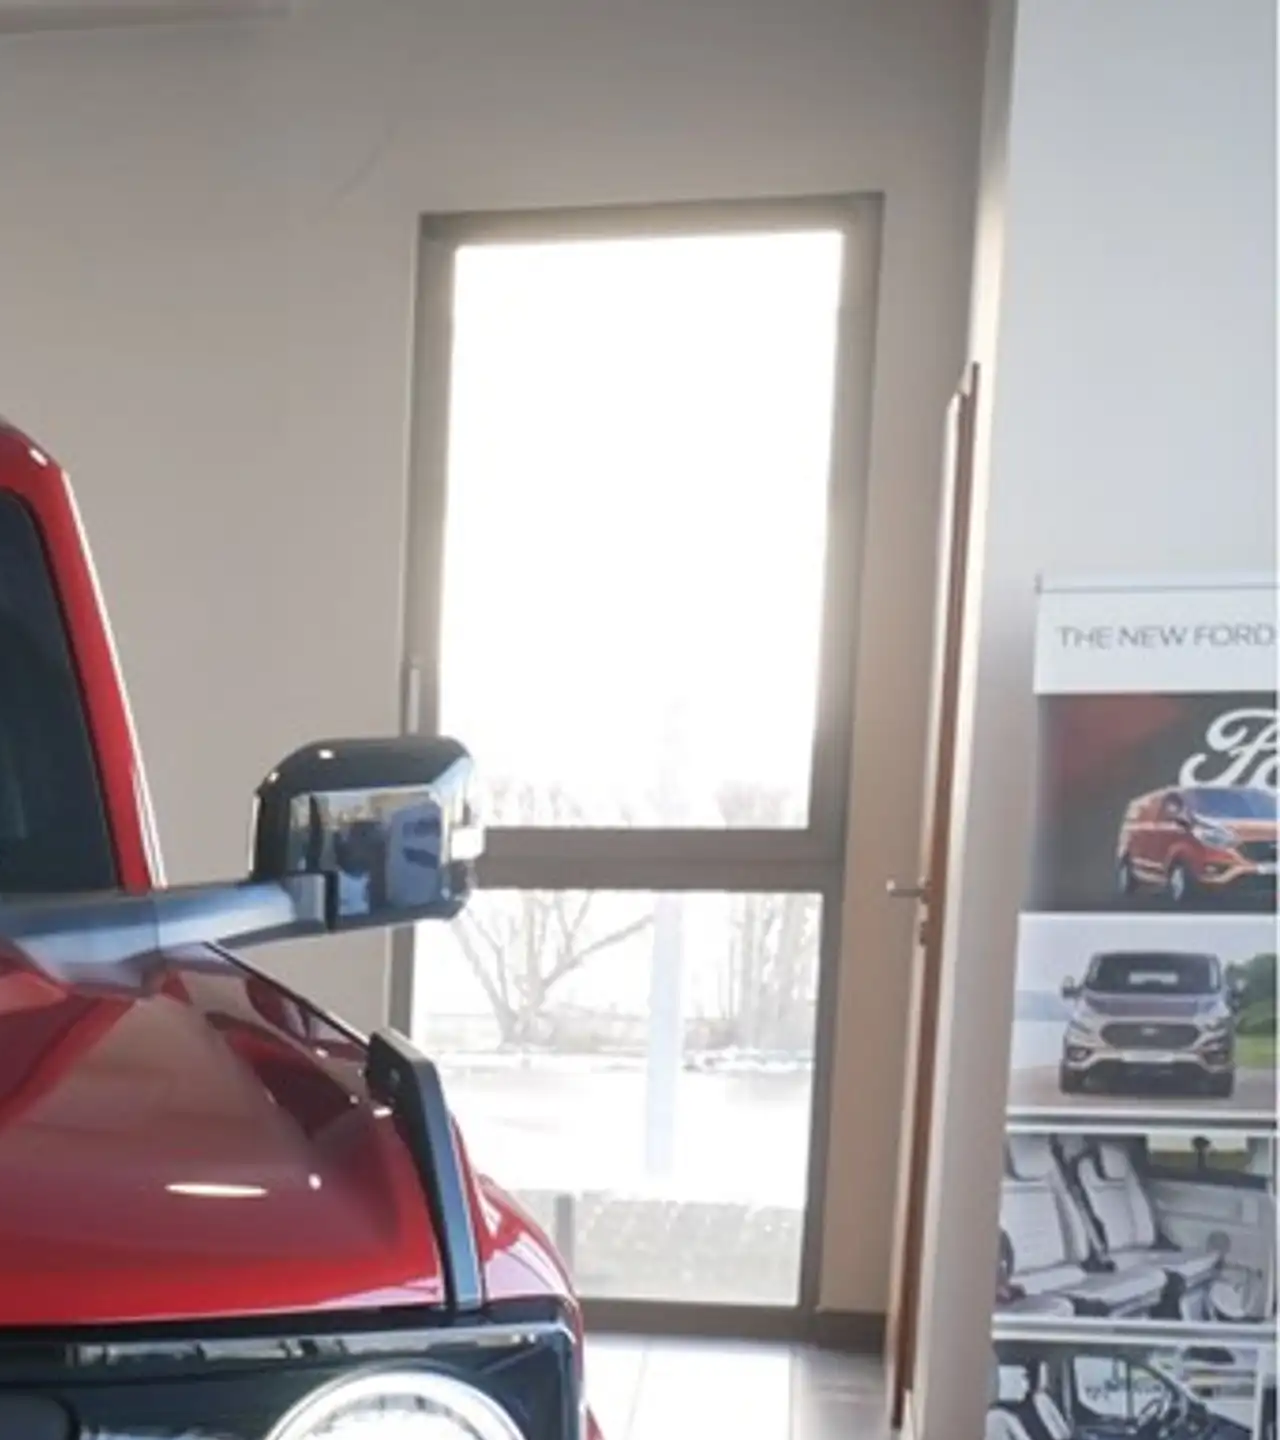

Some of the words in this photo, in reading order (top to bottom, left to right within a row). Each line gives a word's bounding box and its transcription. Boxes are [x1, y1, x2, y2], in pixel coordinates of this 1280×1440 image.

[1057, 625, 1113, 649] THE
[1118, 626, 1188, 648] NEW
[1194, 622, 1276, 647] FORD
